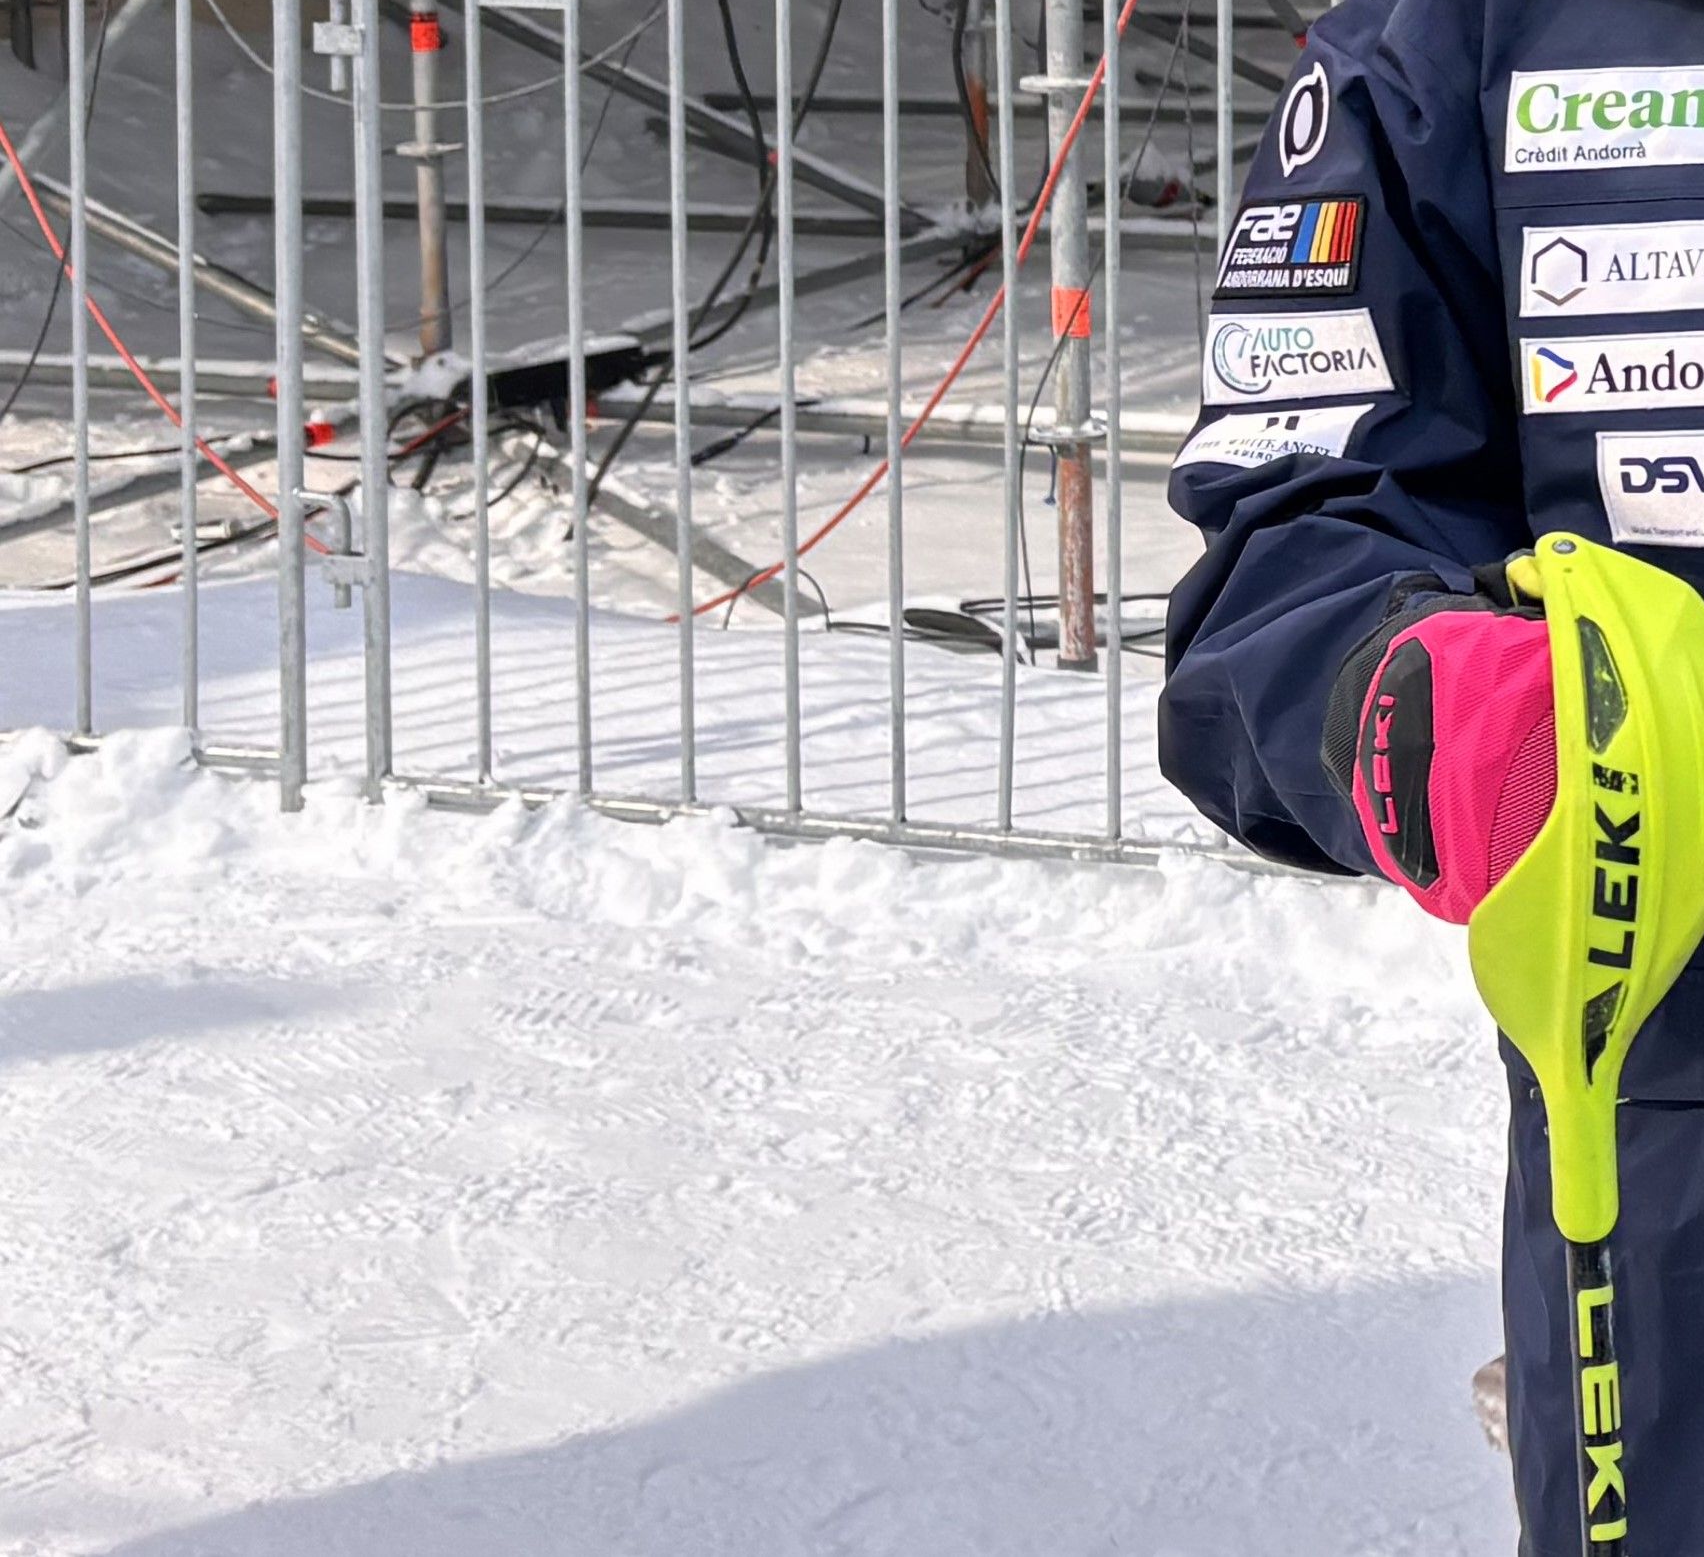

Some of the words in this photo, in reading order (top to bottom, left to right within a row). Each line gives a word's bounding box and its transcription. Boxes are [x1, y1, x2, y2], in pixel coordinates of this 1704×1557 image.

[1514, 145, 1568, 164] Crèdit
[1573, 141, 1647, 161] Andorrà
[1250, 347, 1377, 378] FACTORIA
[1251, 327, 1314, 352] AUTO
[1373, 694, 1400, 835] LEKI
[1587, 761, 1642, 971] LEKI
[1576, 1284, 1628, 1542] LEKI
